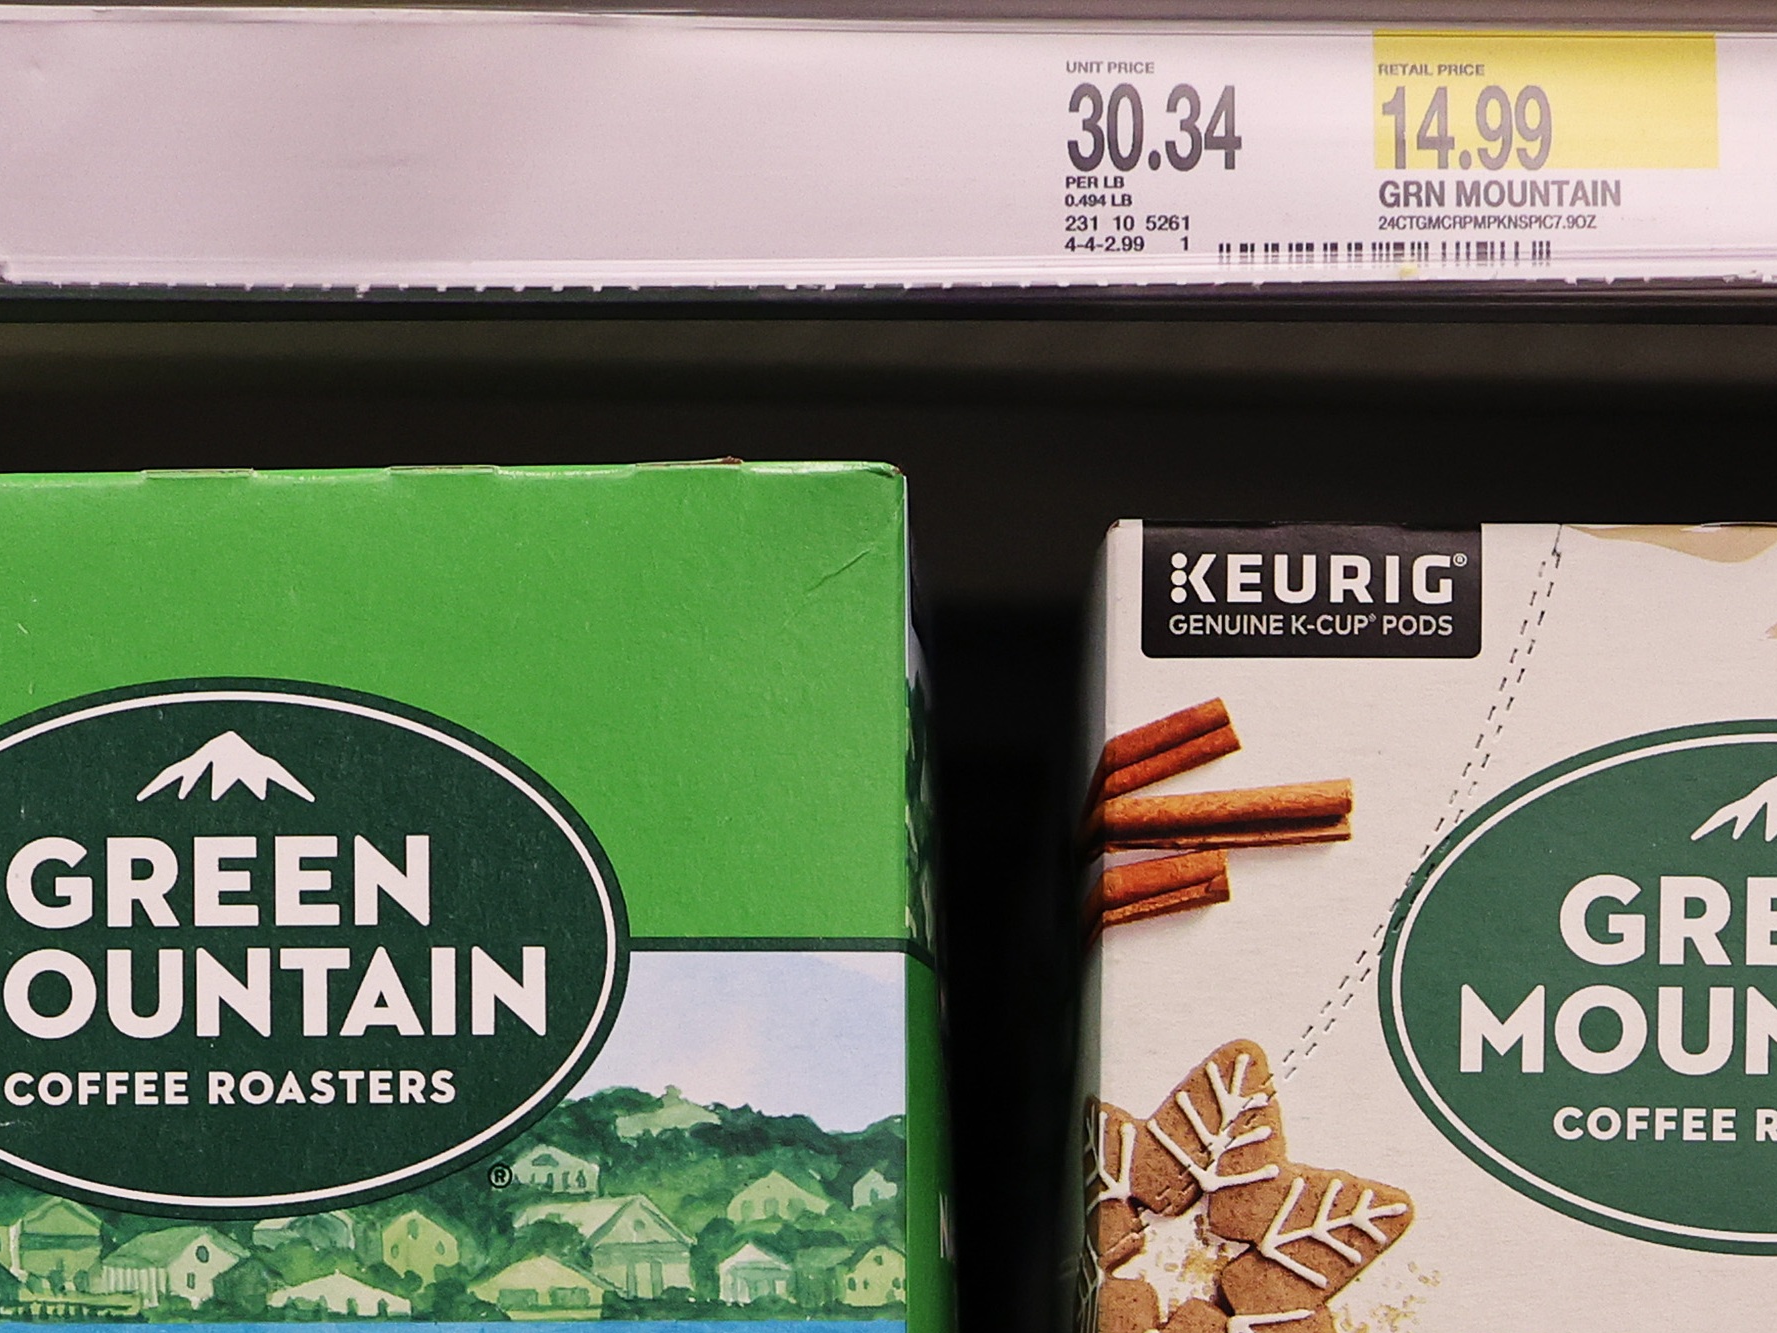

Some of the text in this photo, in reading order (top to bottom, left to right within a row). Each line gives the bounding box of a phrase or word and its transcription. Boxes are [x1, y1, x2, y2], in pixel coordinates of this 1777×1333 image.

[1065, 61, 1155, 74] UNIT PRICE
[1378, 63, 1485, 76] RETAIL PRICE
[1068, 82, 1242, 171] 30.34
[1381, 85, 1553, 171] 14.99
[1378, 179, 1622, 208] GRN MOUNTAIN
[5, 834, 431, 930] GREEN
[4, 1071, 456, 1106] COFFEE ROASTERS
[1553, 1106, 1736, 1142] COFFEE
